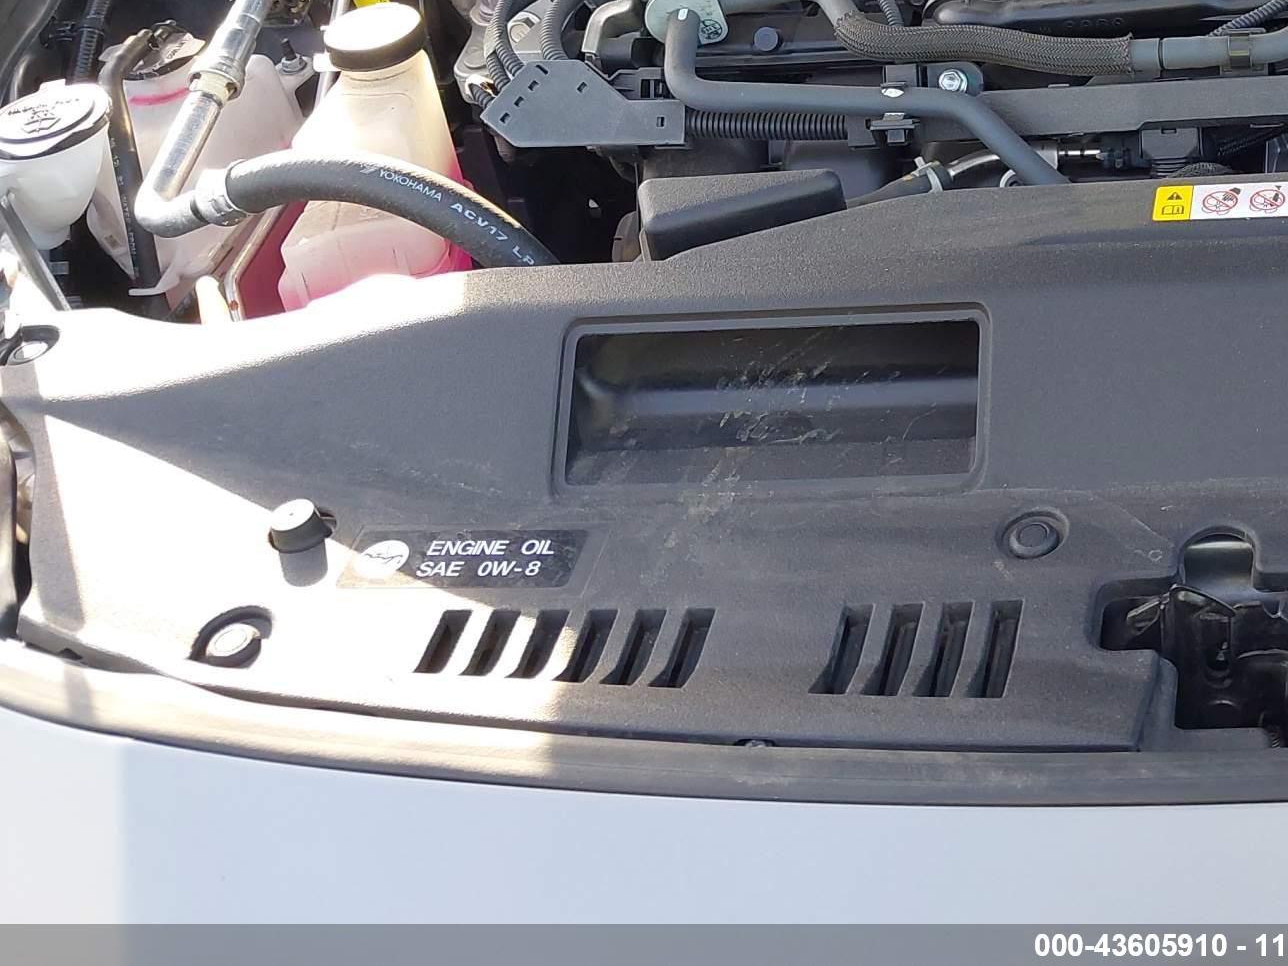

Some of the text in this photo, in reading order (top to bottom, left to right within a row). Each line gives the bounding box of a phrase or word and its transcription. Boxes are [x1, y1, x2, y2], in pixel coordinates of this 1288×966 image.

[379, 168, 442, 202] YOKOHAMA
[450, 203, 508, 241] ACV17
[426, 539, 555, 556] ENGINE OIL
[415, 560, 542, 577] SAE 0W-8
